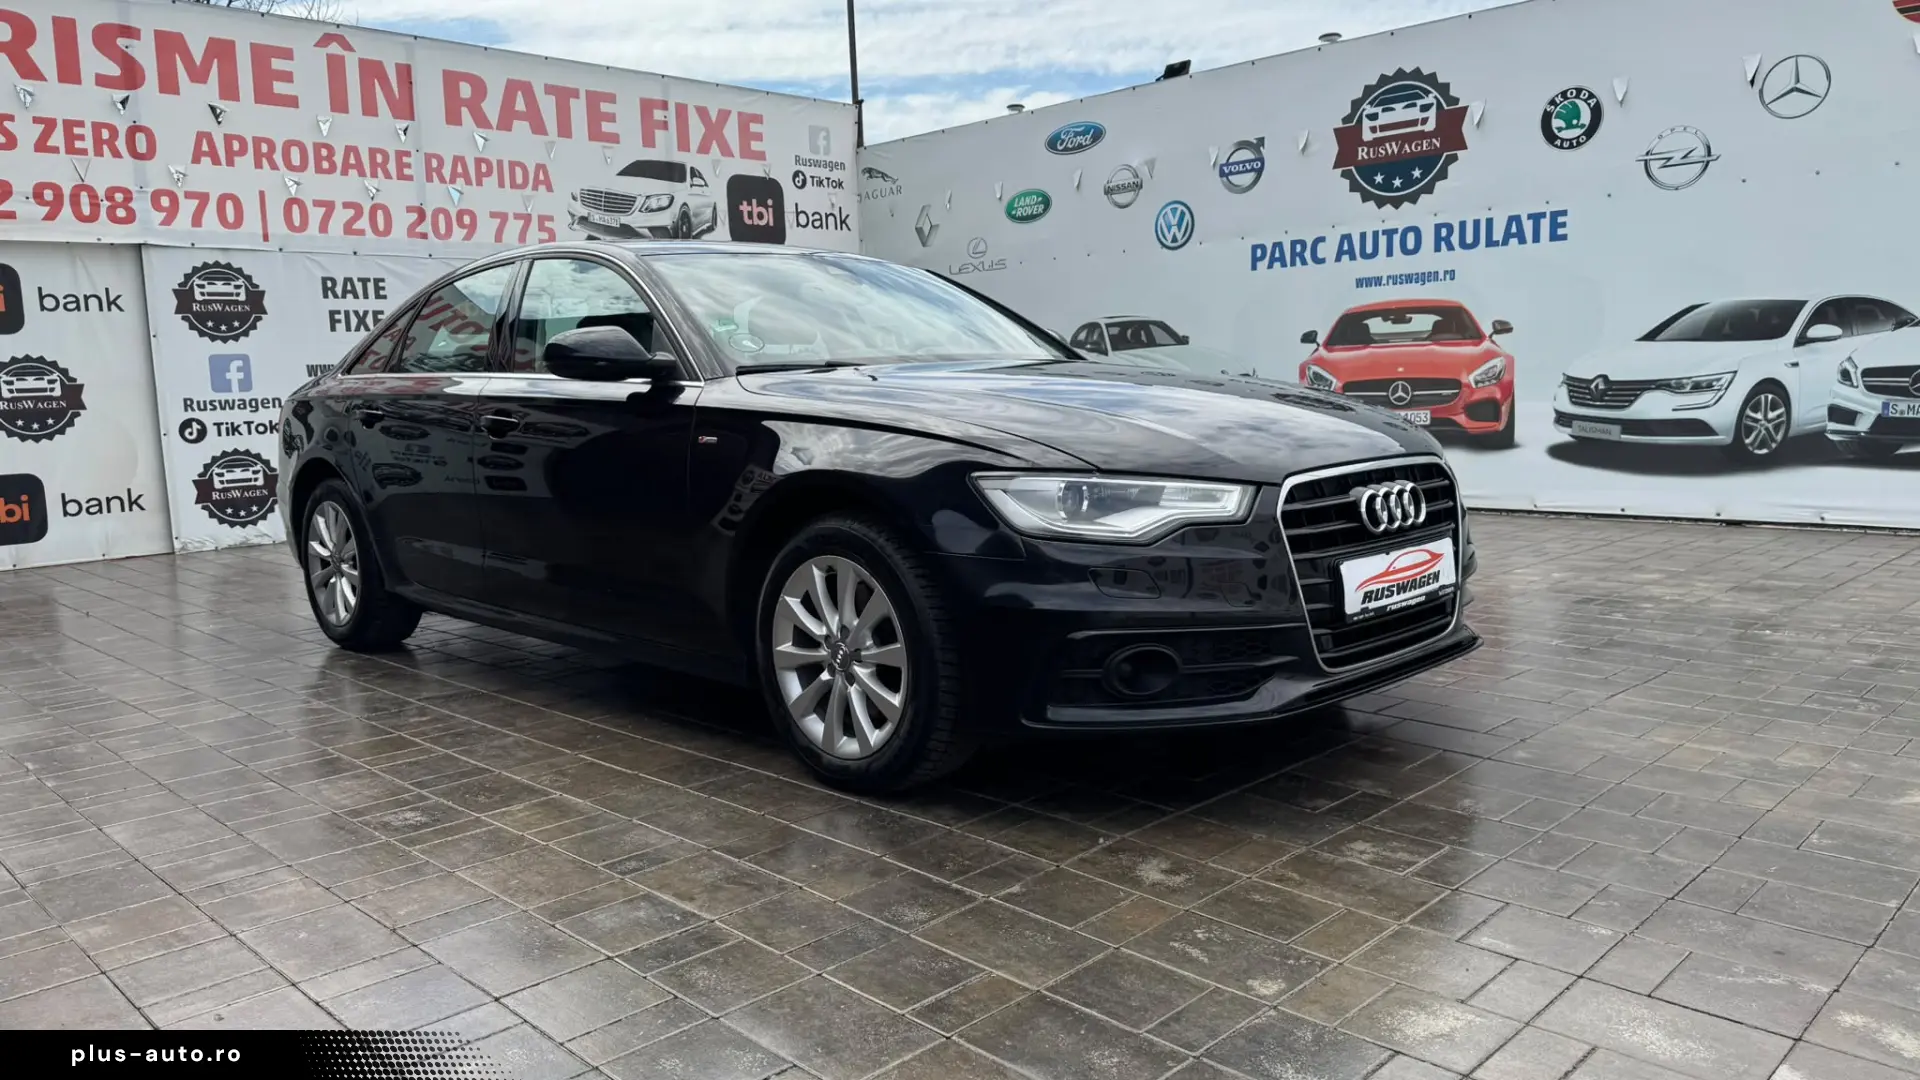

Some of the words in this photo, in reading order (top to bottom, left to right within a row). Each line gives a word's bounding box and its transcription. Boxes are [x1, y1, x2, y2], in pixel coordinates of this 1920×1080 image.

[313, 32, 416, 121] ÎN
[442, 69, 620, 144] RATE
[640, 97, 767, 161] FIXE
[1546, 88, 1598, 112] SKODA
[1057, 126, 1095, 150] Ford
[1554, 135, 1588, 148] AUTO
[1657, 126, 1700, 140] OPEL
[32, 116, 157, 162] ZERO
[191, 131, 414, 182] APROBARE
[424, 152, 555, 193] RAPIDA
[794, 155, 846, 172] Ruswagen
[1222, 160, 1262, 174] VOLVO
[809, 175, 845, 190] TikTok
[1107, 180, 1140, 192] NISSAN
[1014, 195, 1037, 207] LAND
[1016, 204, 1045, 217] ROVER
[32, 181, 137, 225] 908
[150, 188, 244, 230] 970
[283, 197, 393, 238] 0720
[405, 205, 478, 241] 209
[489, 211, 557, 244] 775
[739, 198, 774, 227] tbi
[795, 202, 852, 232] bank
[1250, 236, 1326, 272] PARC
[1334, 225, 1422, 263] AUTO
[1434, 209, 1568, 253] RULATE
[949, 258, 1007, 275] LEXUS
[321, 276, 388, 300] RATE
[1355, 269, 1456, 289] www.ruswagen.ro
[37, 286, 125, 312] bank
[183, 397, 282, 413] Ruswagen
[213, 420, 280, 437] TikTok
[61, 487, 146, 517] bank
[1361, 569, 1441, 605] RUSWAGEN
[1386, 595, 1426, 611] ruswagen
